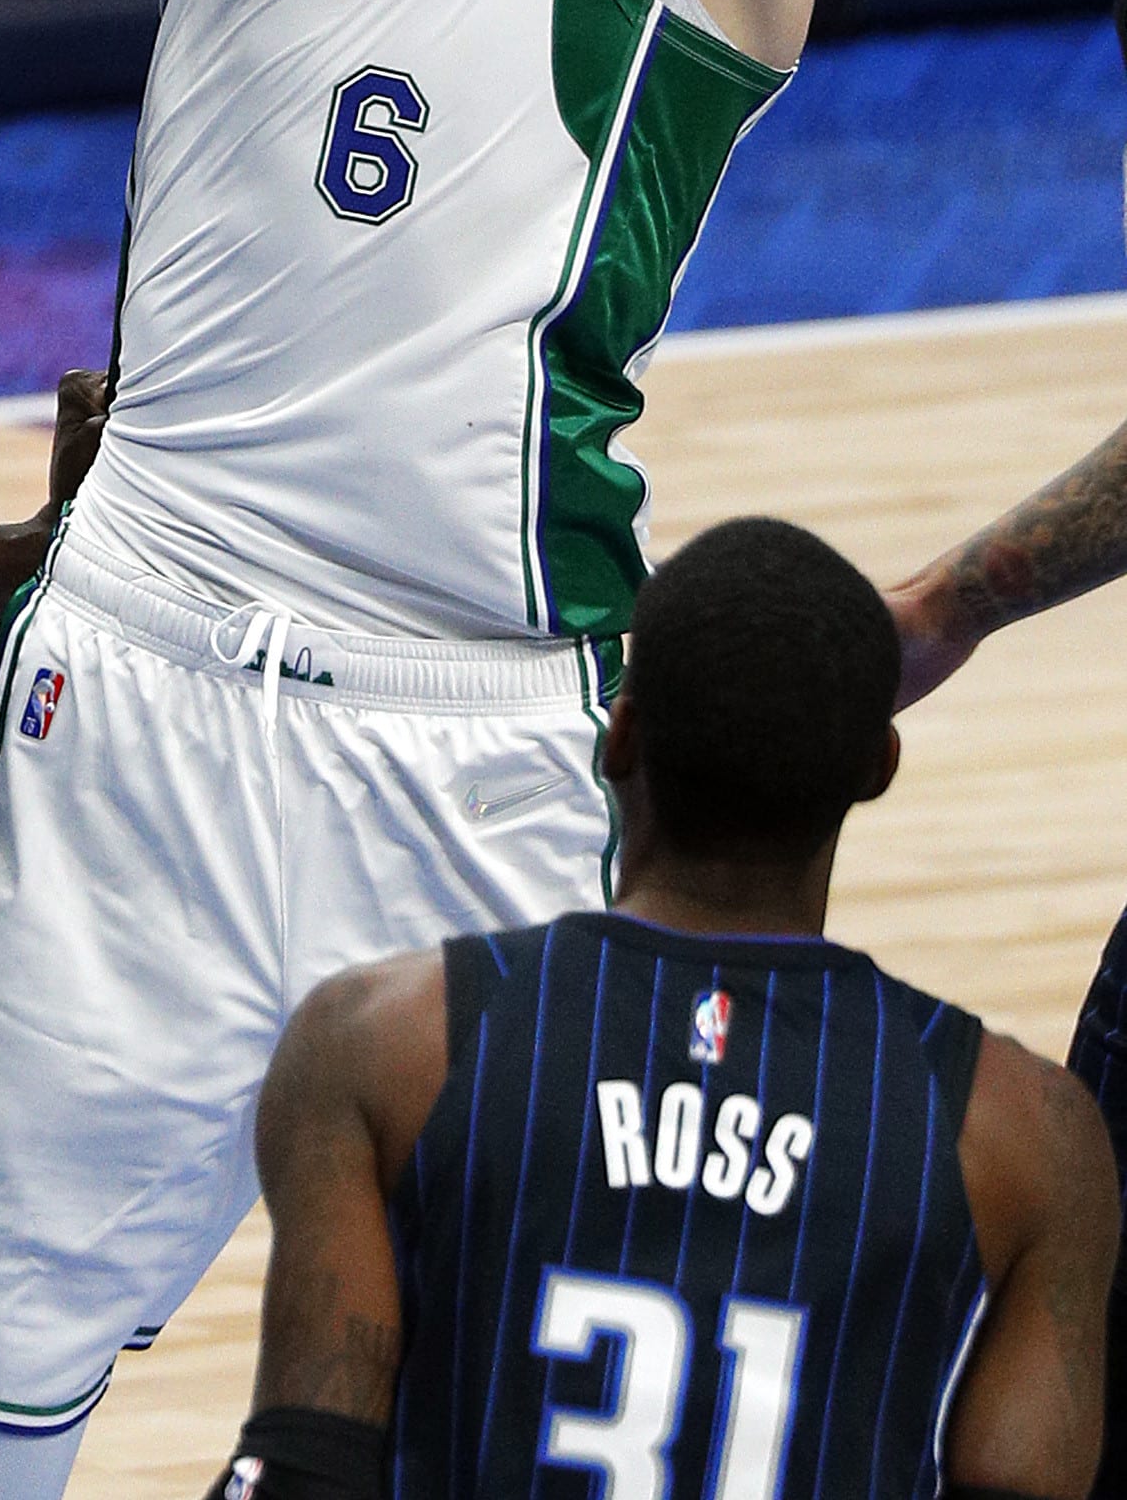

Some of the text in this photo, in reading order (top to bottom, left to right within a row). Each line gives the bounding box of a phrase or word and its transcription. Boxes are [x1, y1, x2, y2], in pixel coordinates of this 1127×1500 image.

[314, 64, 430, 226] 6
[596, 1079, 813, 1216] ROSS
[529, 1263, 811, 1500] 31
